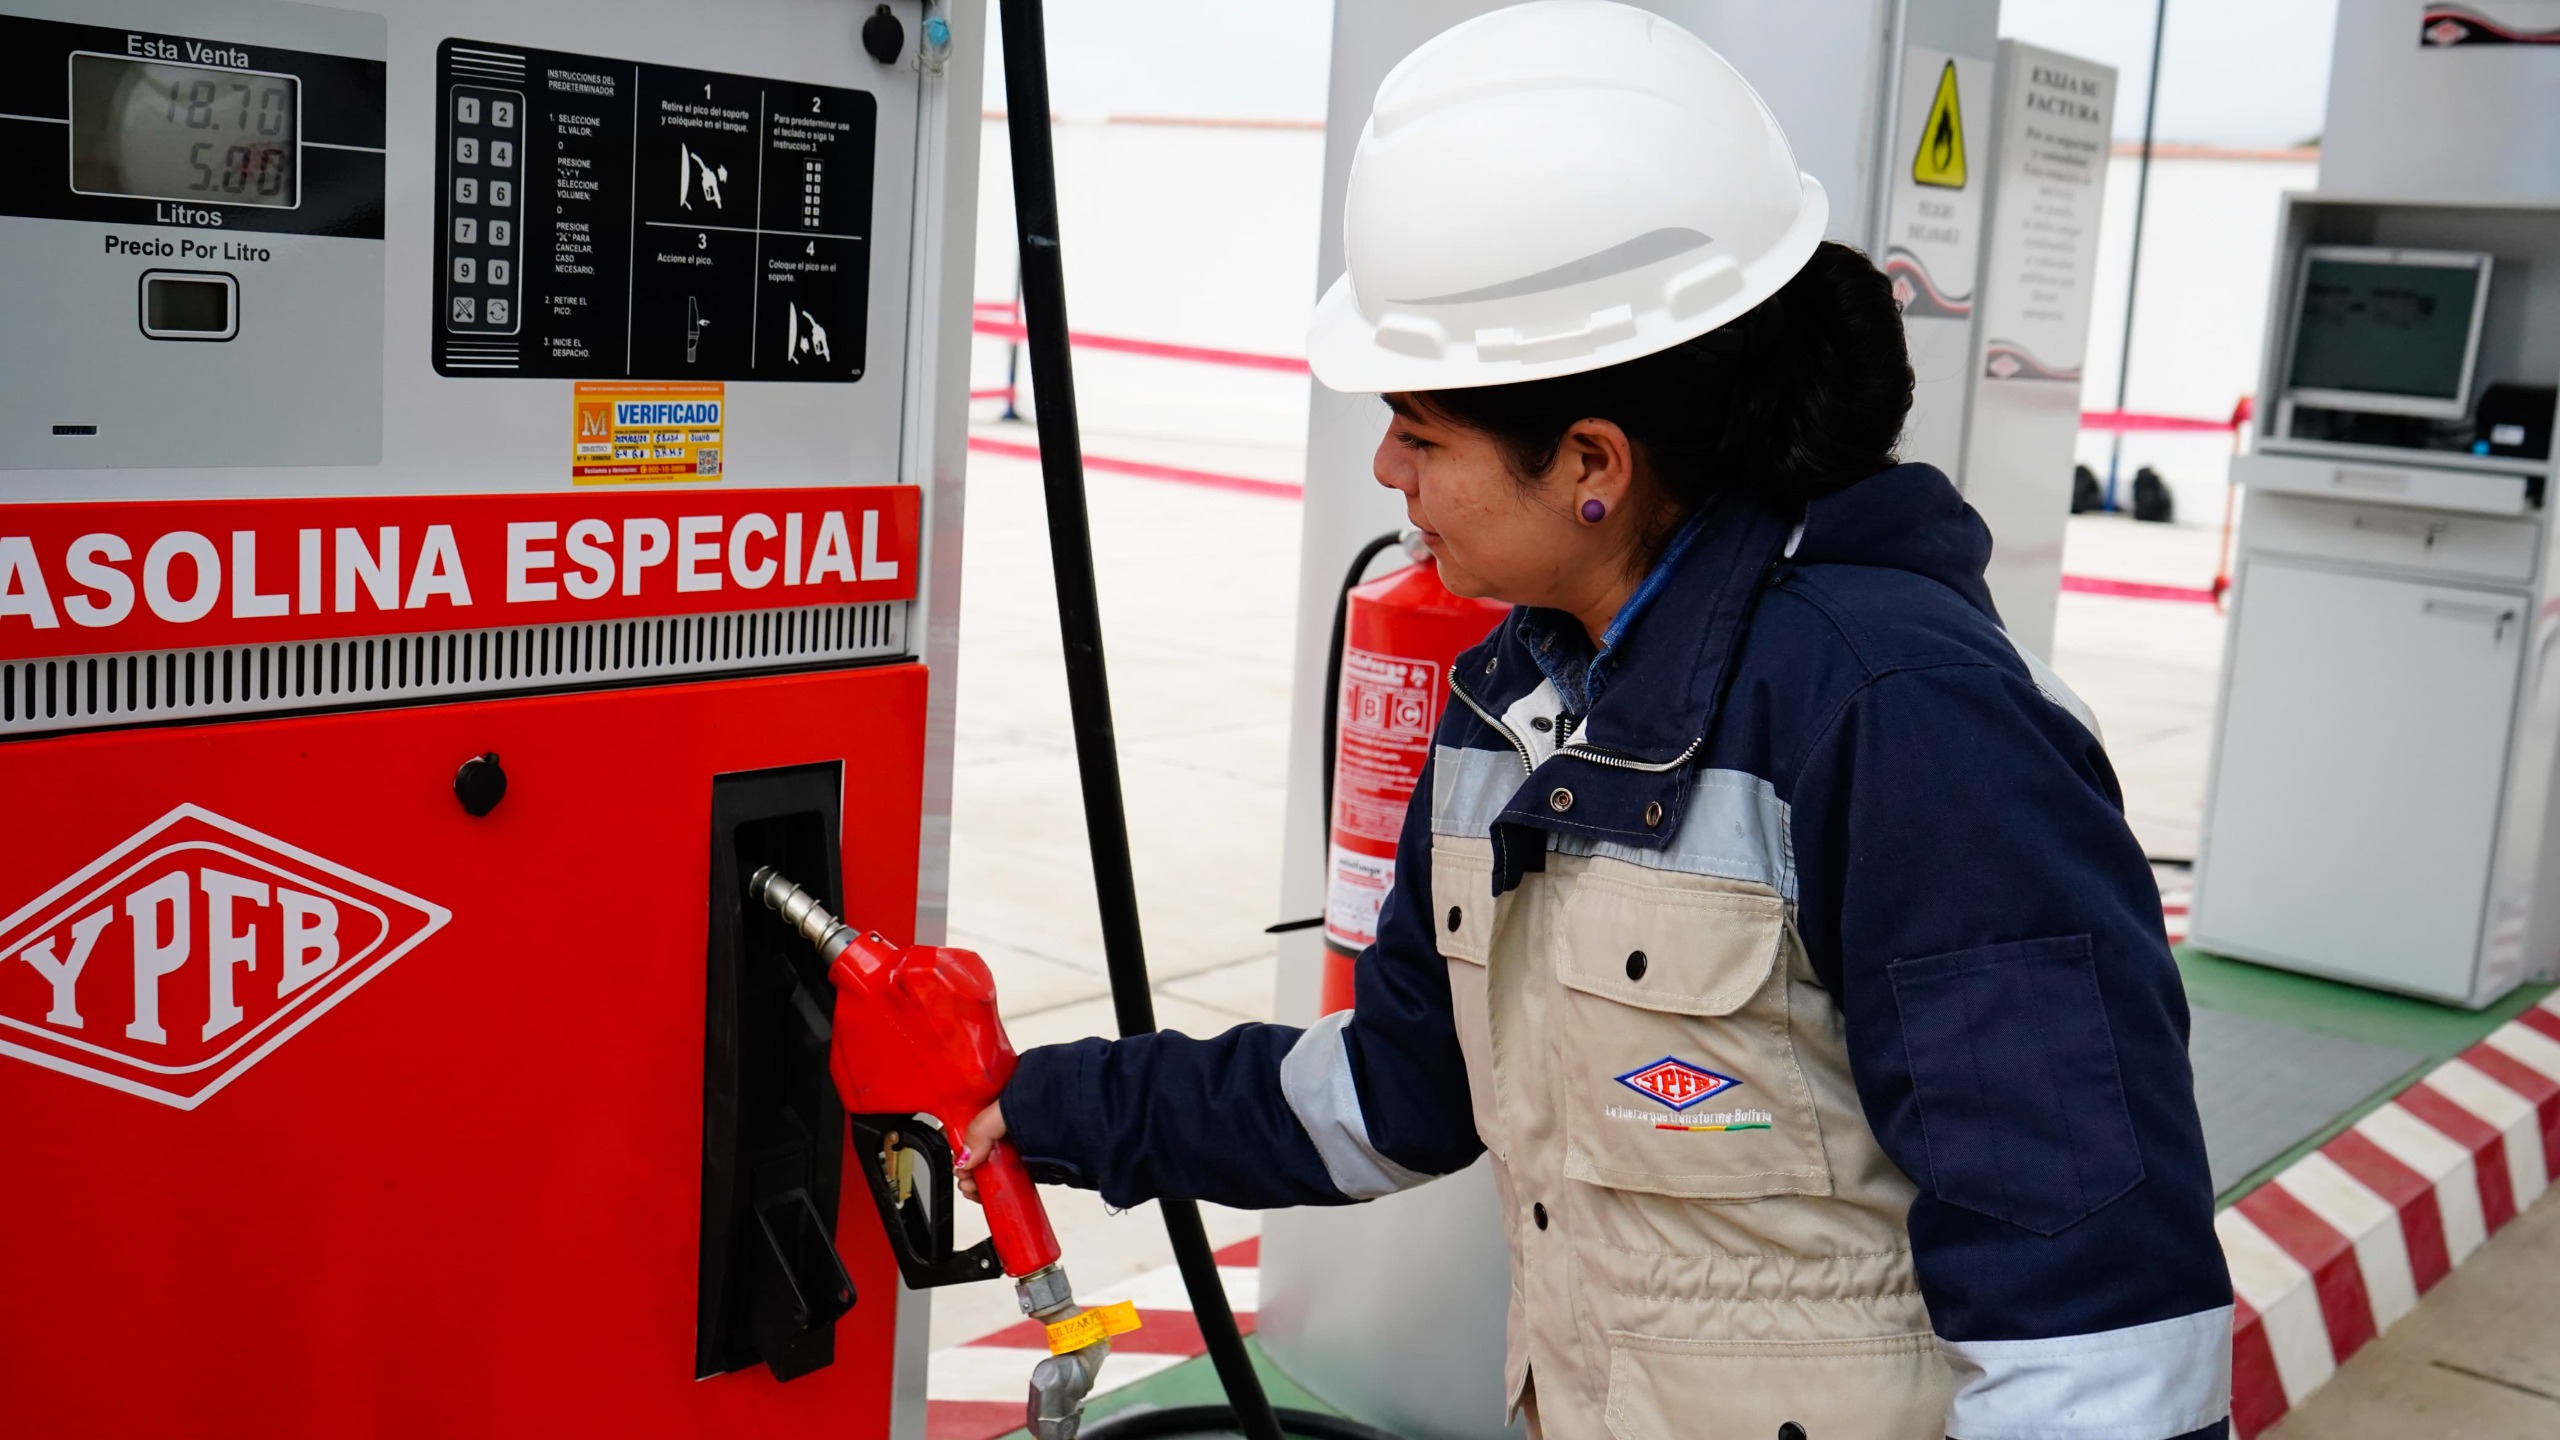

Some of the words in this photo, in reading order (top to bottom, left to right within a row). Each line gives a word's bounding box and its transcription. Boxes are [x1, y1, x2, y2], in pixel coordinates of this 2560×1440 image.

[127, 34, 178, 61] Esta
[186, 41, 249, 68] Venta
[547, 69, 601, 84] INSTRUCCIONES
[600, 76, 615, 85] DEL
[548, 80, 614, 96] PREDETERMINADOR
[704, 84, 711, 100] 1
[166, 80, 285, 136] 18.70
[661, 101, 683, 112] Retire
[685, 104, 692, 113] el
[693, 105, 709, 117] pico
[710, 106, 721, 116] del
[723, 108, 749, 121] soporte
[812, 97, 820, 112] 2
[2028, 91, 2099, 124] FACTURA
[465, 104, 473, 118] 1
[499, 107, 508, 122] 2
[558, 114, 600, 126] SELECCIONE
[558, 125, 567, 134] EL
[661, 117, 666, 125] y
[668, 115, 703, 129] colóquelo
[715, 120, 722, 129] el
[723, 121, 748, 132] tanque.
[774, 113, 790, 124] Para
[791, 117, 837, 131] predeterminar
[838, 123, 850, 131] use
[774, 127, 780, 136] el
[781, 128, 806, 139] teclado
[813, 132, 827, 142] siga
[828, 133, 835, 142] la
[464, 144, 472, 158] 3
[497, 147, 506, 161] 4
[773, 140, 811, 151] instrucción
[188, 143, 285, 196] 5.00
[557, 157, 591, 169] PRESIONE
[463, 184, 472, 198] 5
[496, 186, 505, 201] 6
[557, 179, 599, 191] SELECCIONE
[156, 202, 223, 226] Litros
[462, 223, 470, 238] 7
[496, 226, 504, 240] 8
[556, 222, 590, 232] PRESIONE
[572, 233, 590, 243] PARA
[698, 233, 707, 249] 3
[105, 235, 174, 257] Precio
[181, 239, 217, 259] Por
[224, 242, 270, 262] Litro
[806, 241, 815, 256] 4
[555, 254, 575, 263] CASO
[657, 253, 686, 264] Accione
[688, 254, 695, 264] el
[696, 255, 713, 267] pico.
[769, 259, 797, 271] Coloque
[798, 261, 804, 270] el
[805, 262, 820, 272] pico
[830, 263, 837, 272] el
[461, 263, 470, 278] 9
[494, 265, 503, 280] 0
[768, 273, 795, 283] soporte.
[554, 296, 578, 306] RETIRE
[579, 297, 588, 306] EL
[553, 338, 572, 347] INICIE
[573, 339, 582, 347] EL
[553, 349, 590, 358] DESPACHO.
[617, 404, 718, 424] VERIFICADO
[582, 410, 607, 436] M
[0, 524, 472, 629] ASOLINA
[507, 509, 898, 603] ESPECIAL
[20, 867, 339, 1045] YPFB
[1641, 1068, 1710, 1098] YPFB
[1605, 1104, 1616, 1117] La
[1650, 1111, 1668, 1124] que
[1669, 1110, 1732, 1124] transforma
[1734, 1109, 1772, 1122] Bolivia
